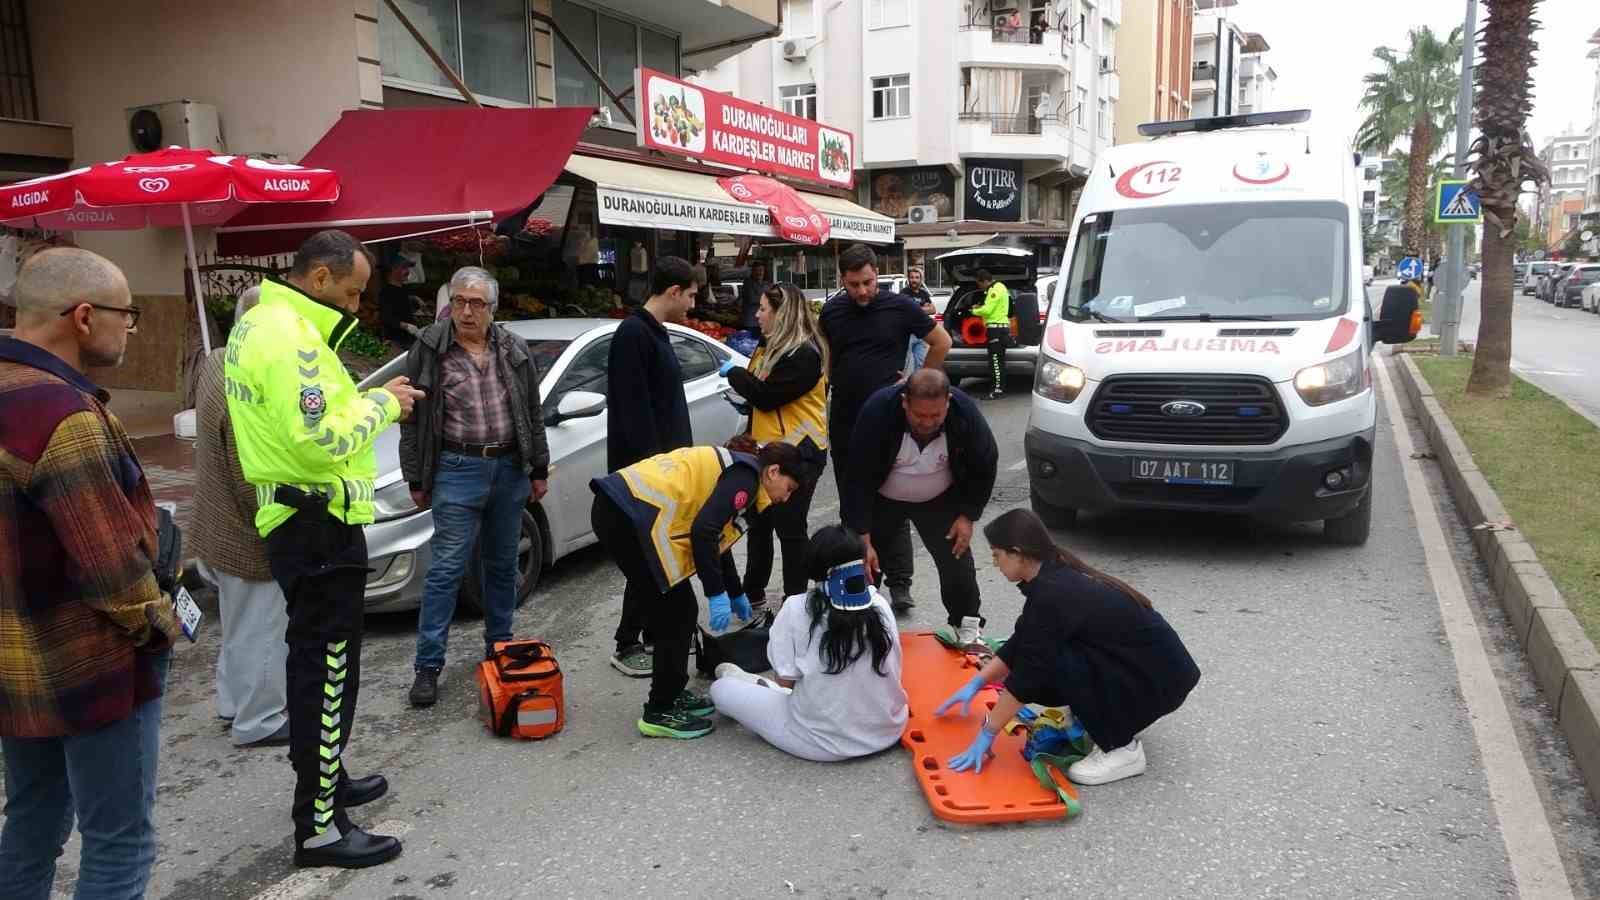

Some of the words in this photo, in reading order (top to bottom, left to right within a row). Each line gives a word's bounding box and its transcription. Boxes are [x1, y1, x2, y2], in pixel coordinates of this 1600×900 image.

[721, 104, 808, 145] DURANOĞULLARI
[712, 129, 776, 163] KARDEŞLER
[777, 145, 815, 171] MARKET
[1143, 167, 1182, 184] 112
[603, 195, 697, 219] DURANOĞULLARI
[699, 207, 750, 226] KARDEŞLER
[1140, 460, 1158, 476] 07
[1163, 461, 1191, 477] AAT
[1201, 462, 1228, 479] 112
